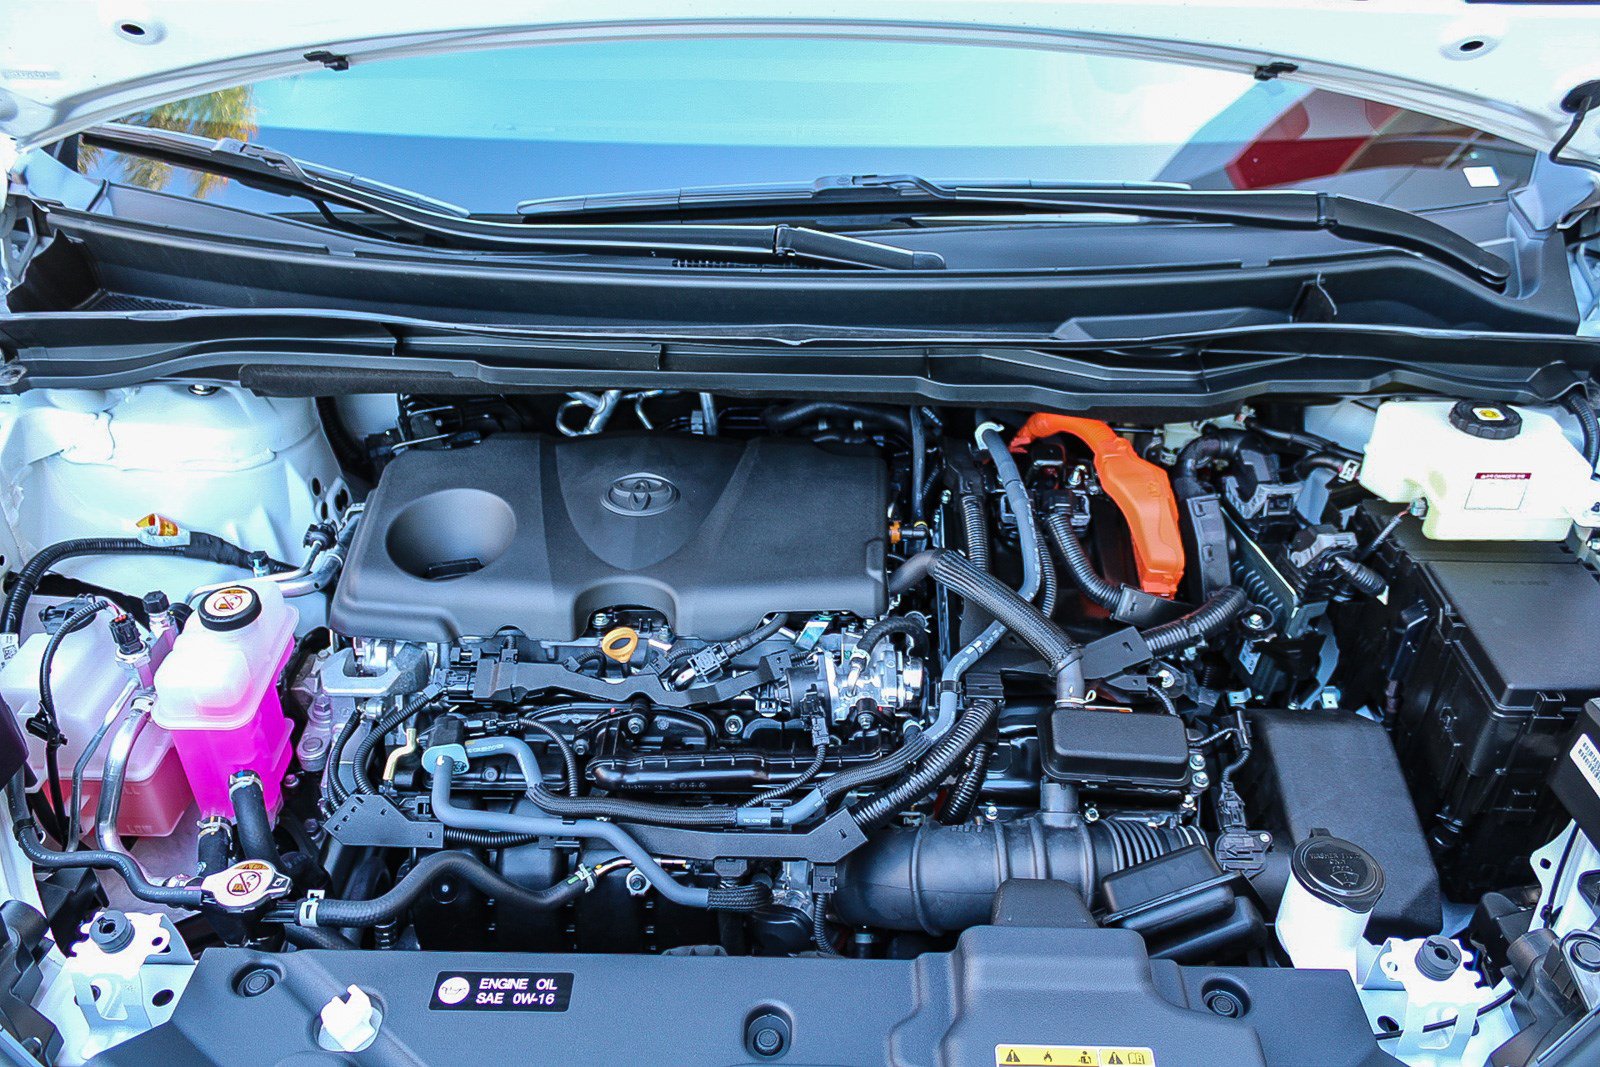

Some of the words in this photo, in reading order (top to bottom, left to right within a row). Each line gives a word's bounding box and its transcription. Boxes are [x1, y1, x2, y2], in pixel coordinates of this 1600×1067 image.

[478, 978, 530, 990] ENGINE
[535, 978, 558, 991] OIL
[475, 992, 505, 1004] SAE
[512, 993, 556, 1005] 0W-16
